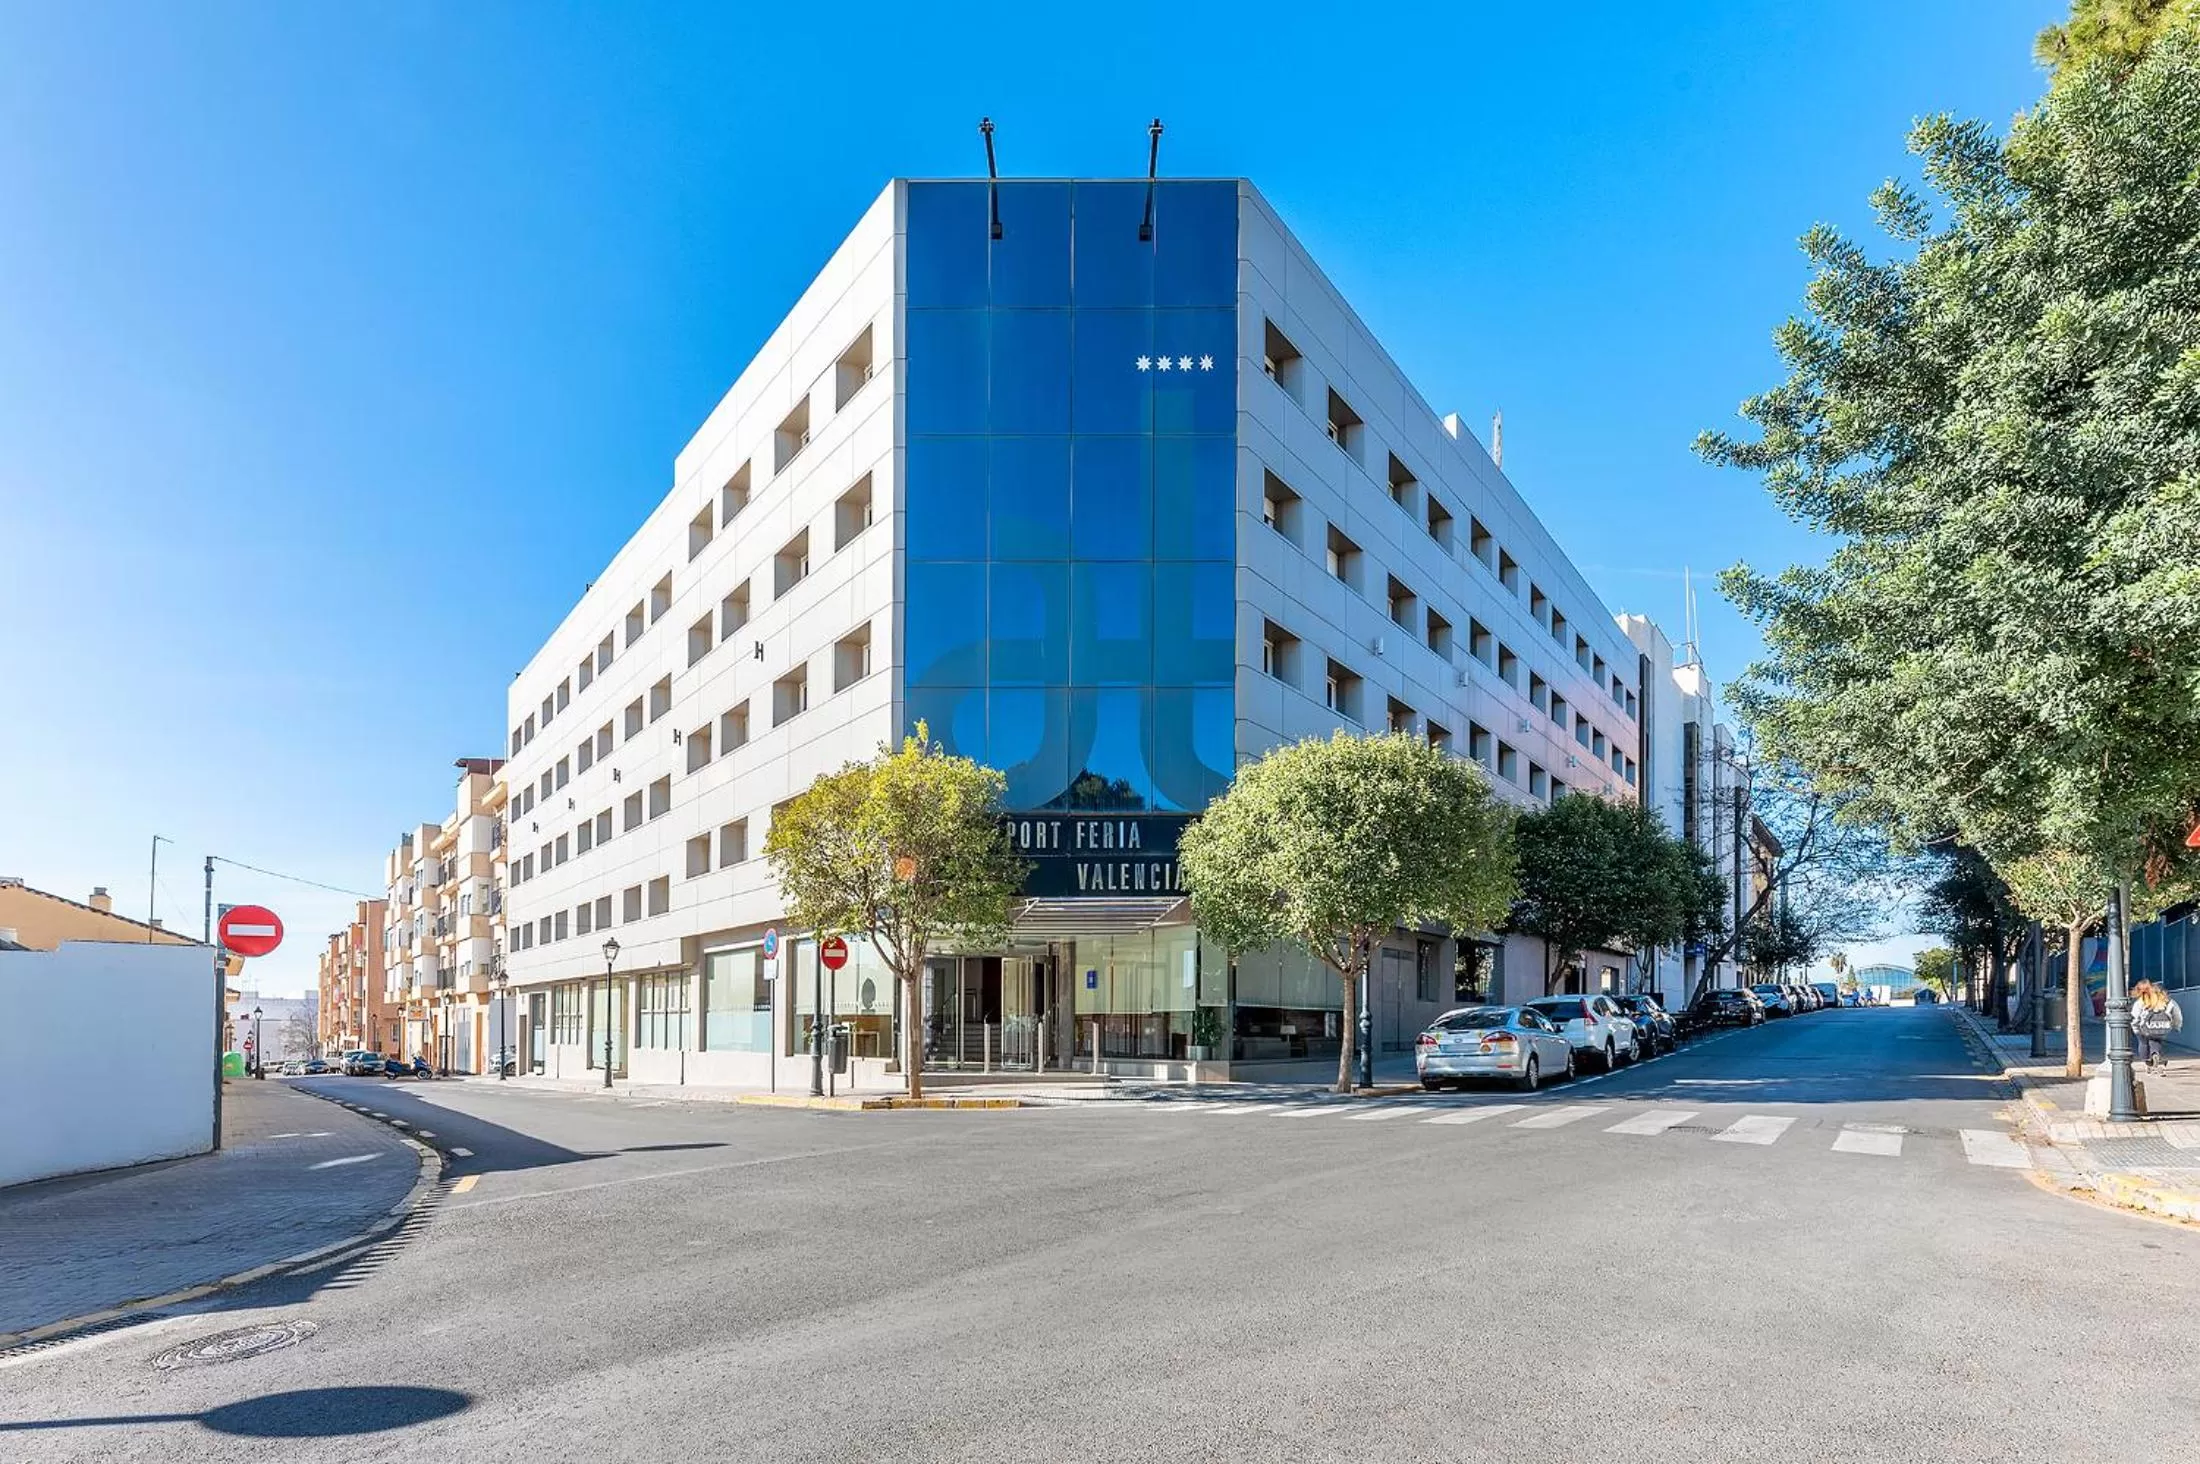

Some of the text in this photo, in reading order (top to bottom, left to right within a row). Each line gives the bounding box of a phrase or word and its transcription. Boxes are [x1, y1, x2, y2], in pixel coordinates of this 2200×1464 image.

[1007, 821, 1141, 849] PORT FERIA
[1077, 863, 1185, 890] VALENCIA
